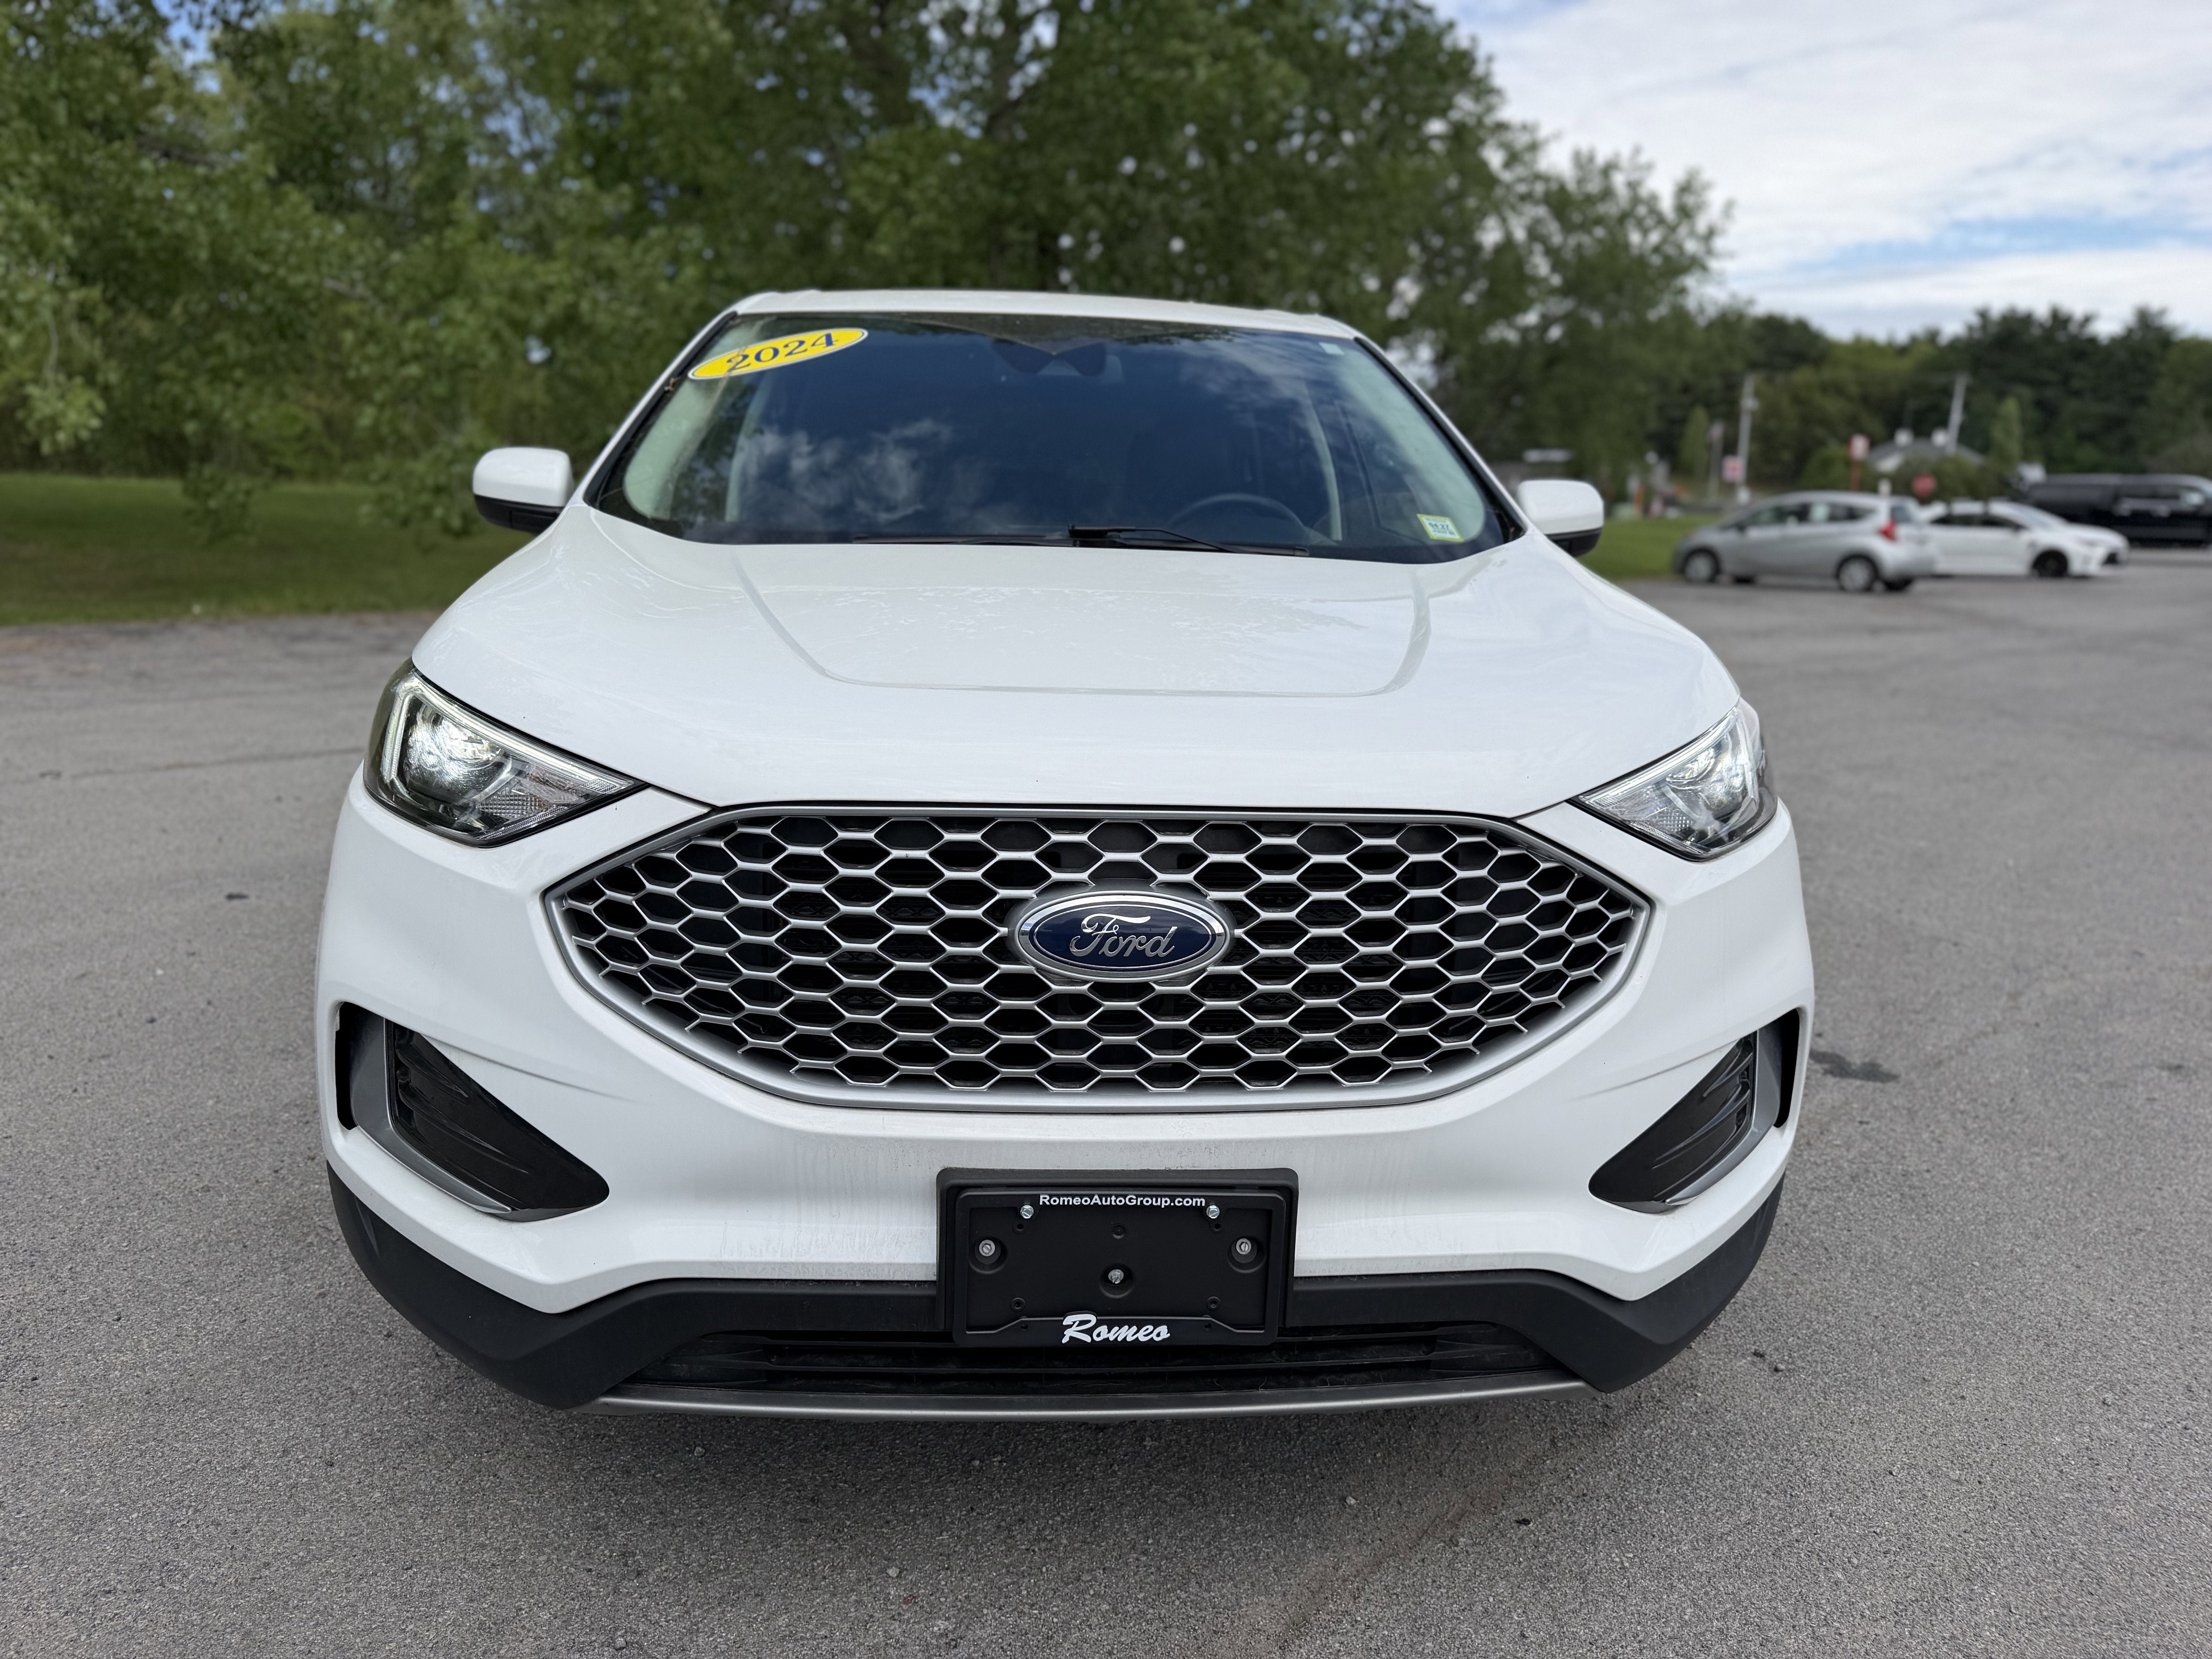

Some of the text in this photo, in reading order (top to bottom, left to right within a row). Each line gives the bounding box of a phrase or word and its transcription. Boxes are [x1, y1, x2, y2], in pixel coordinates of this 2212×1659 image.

[726, 333, 838, 373] 2024
[1070, 913, 1178, 957] Ford
[1039, 1195, 1205, 1208] RomeoAutoGroup.com
[1062, 1314, 1170, 1343] Romeo
